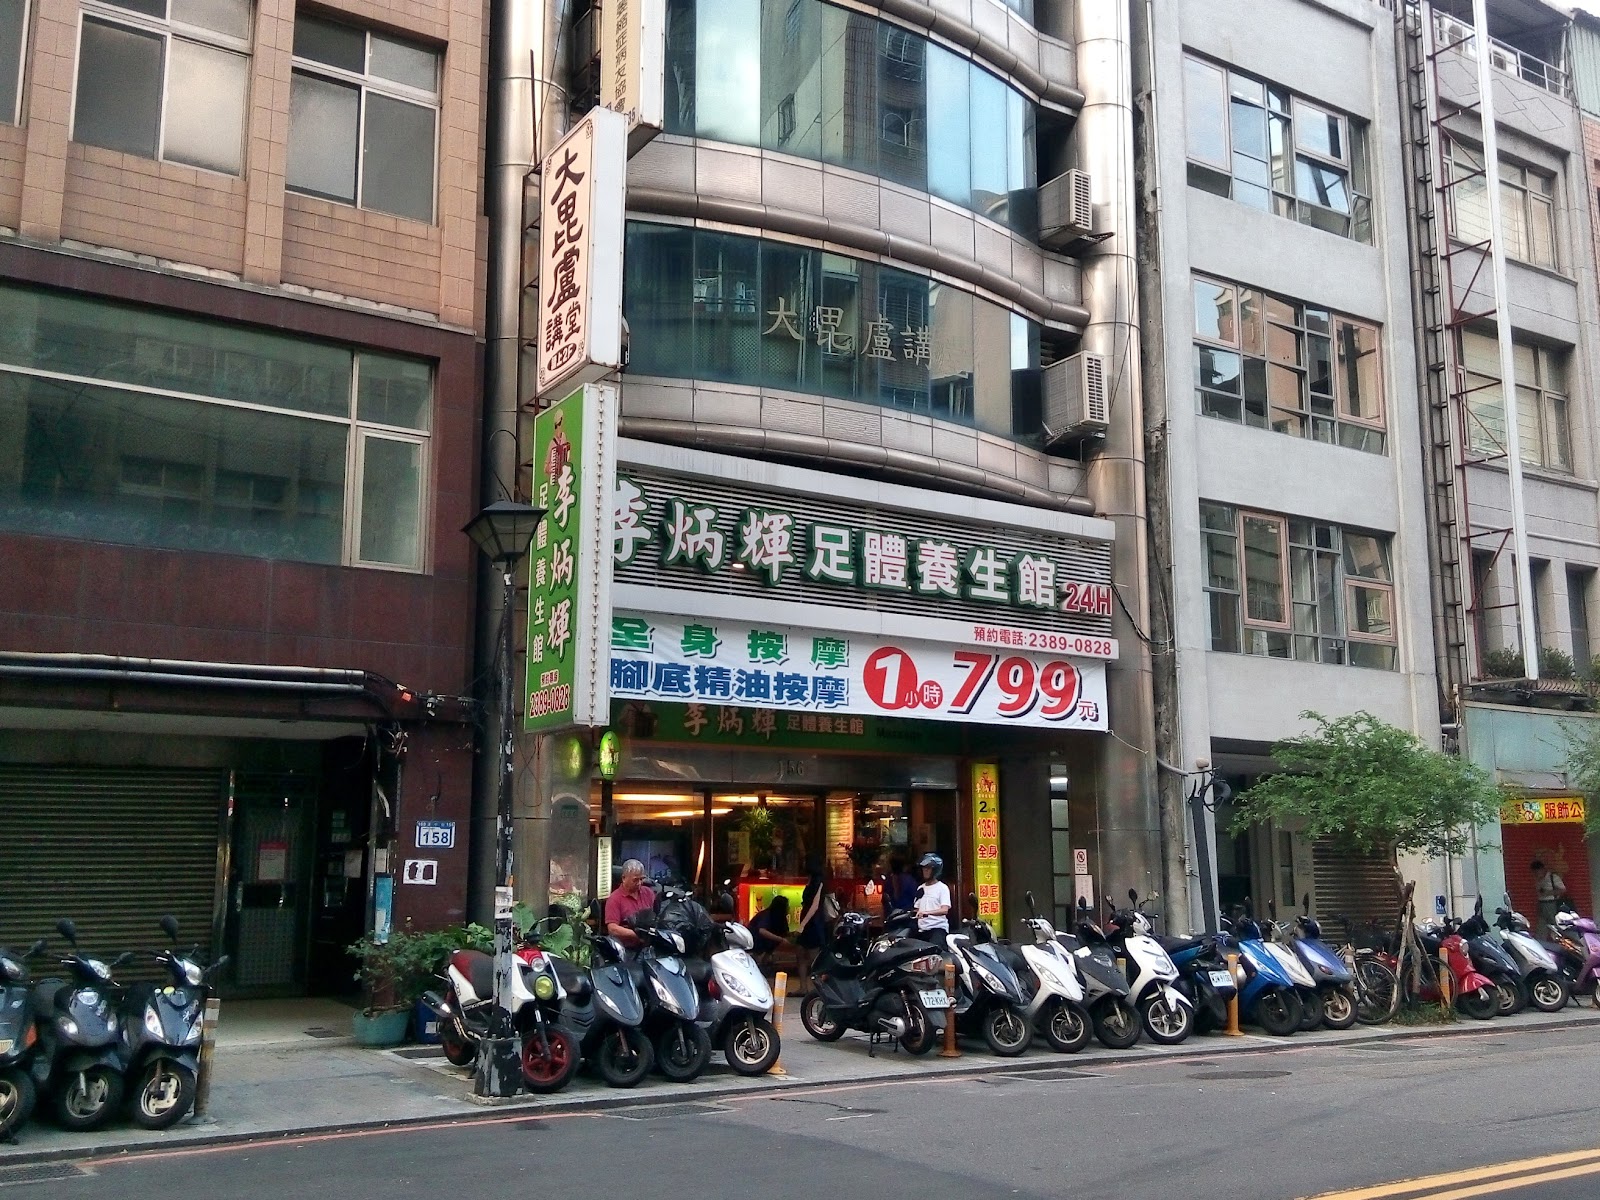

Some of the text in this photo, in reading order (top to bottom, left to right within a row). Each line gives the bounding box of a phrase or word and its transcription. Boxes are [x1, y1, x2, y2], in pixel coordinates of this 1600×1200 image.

[547, 464, 576, 658] 李炳輝
[1064, 582, 1113, 617] 24H
[611, 616, 849, 668] 全身按摩
[610, 657, 849, 706] 腳底精油按摩
[530, 684, 570, 718] 2389-0828
[422, 831, 449, 844] 158
[977, 817, 998, 839] 1350
[977, 844, 998, 860] 全身
